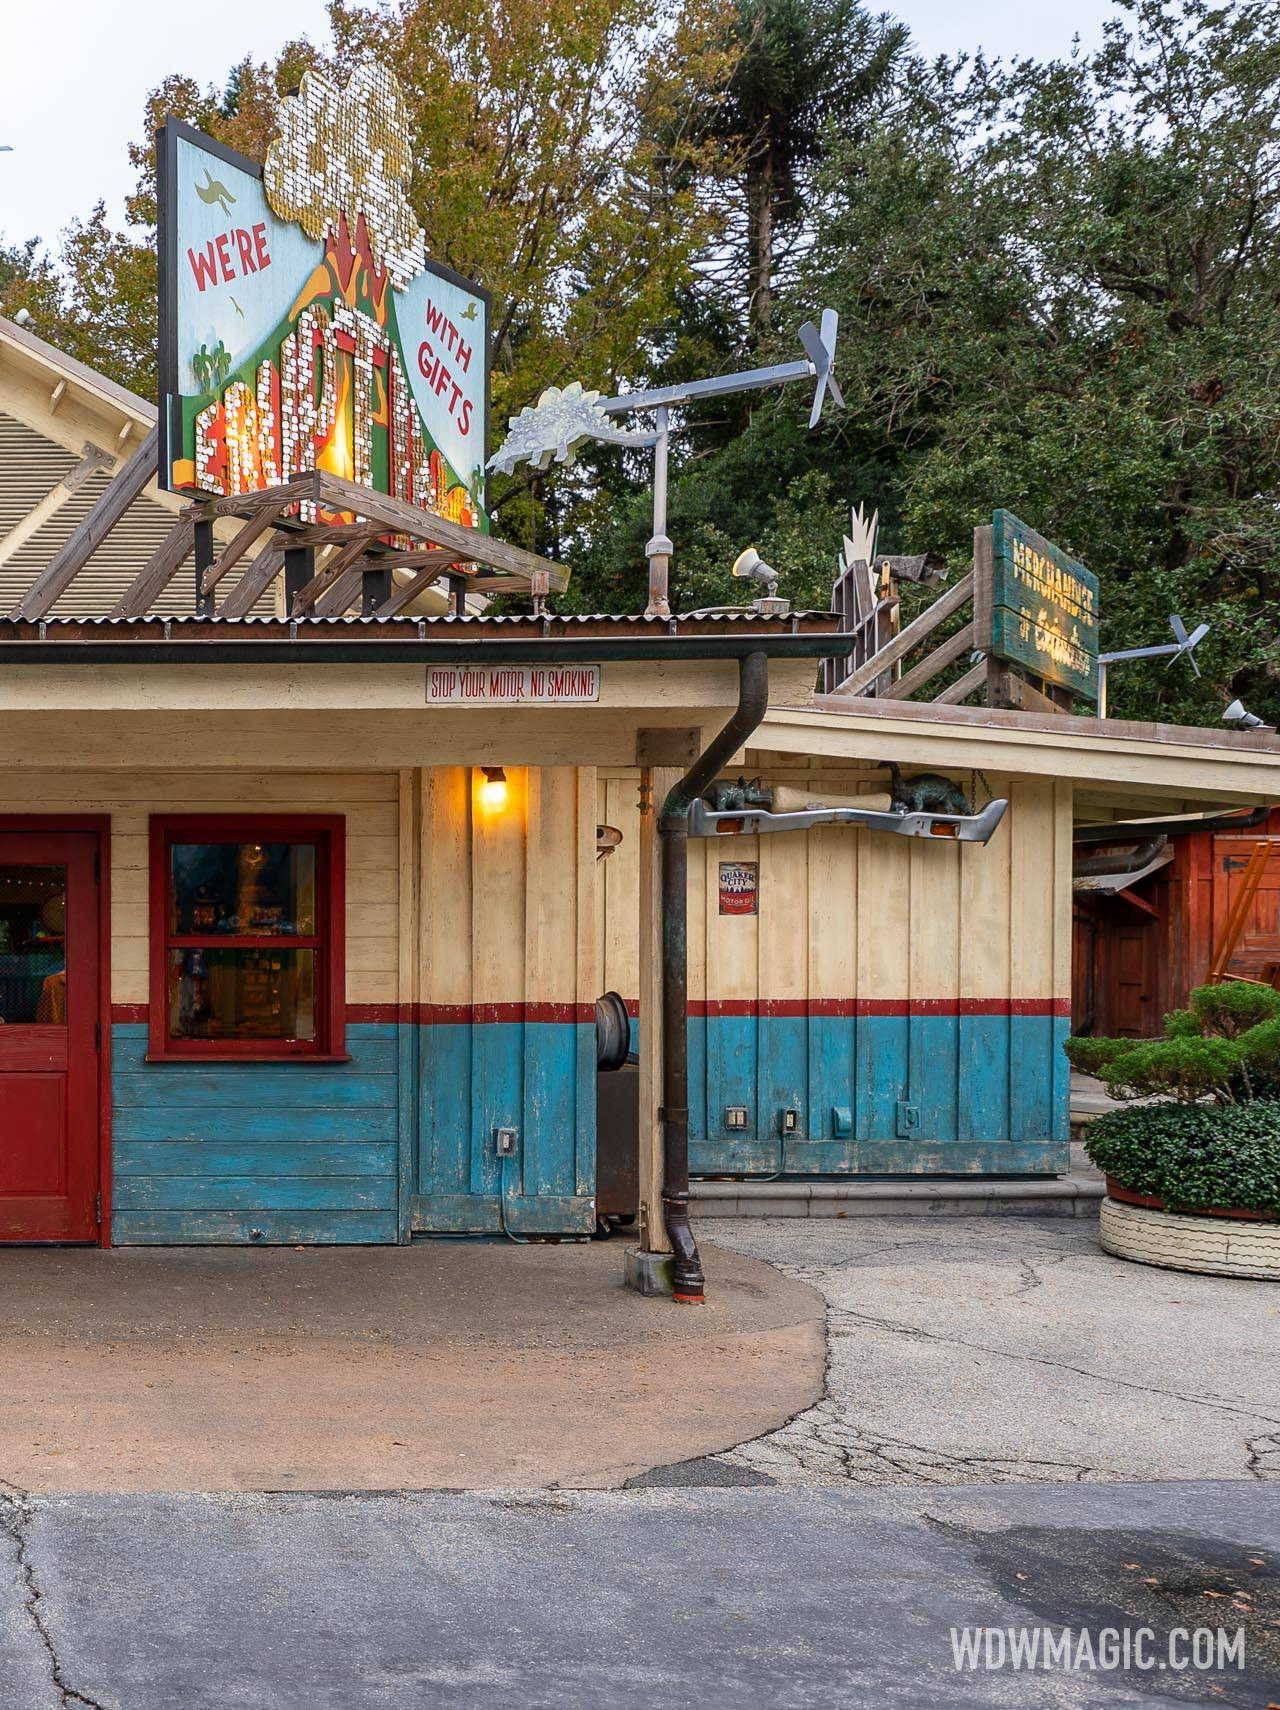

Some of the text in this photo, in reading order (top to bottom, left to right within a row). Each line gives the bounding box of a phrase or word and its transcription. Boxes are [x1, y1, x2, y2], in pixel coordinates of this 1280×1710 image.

[186, 222, 271, 293] WE'RE
[426, 298, 473, 374] WITH
[417, 340, 474, 437] GIFTS
[1012, 537, 1093, 627] MERCHANDISE
[431, 670, 595, 698] STOP YOUR MOTOR NO SMOKING
[720, 871, 754, 882] QUAKER
[720, 895, 743, 904] MOTOR
